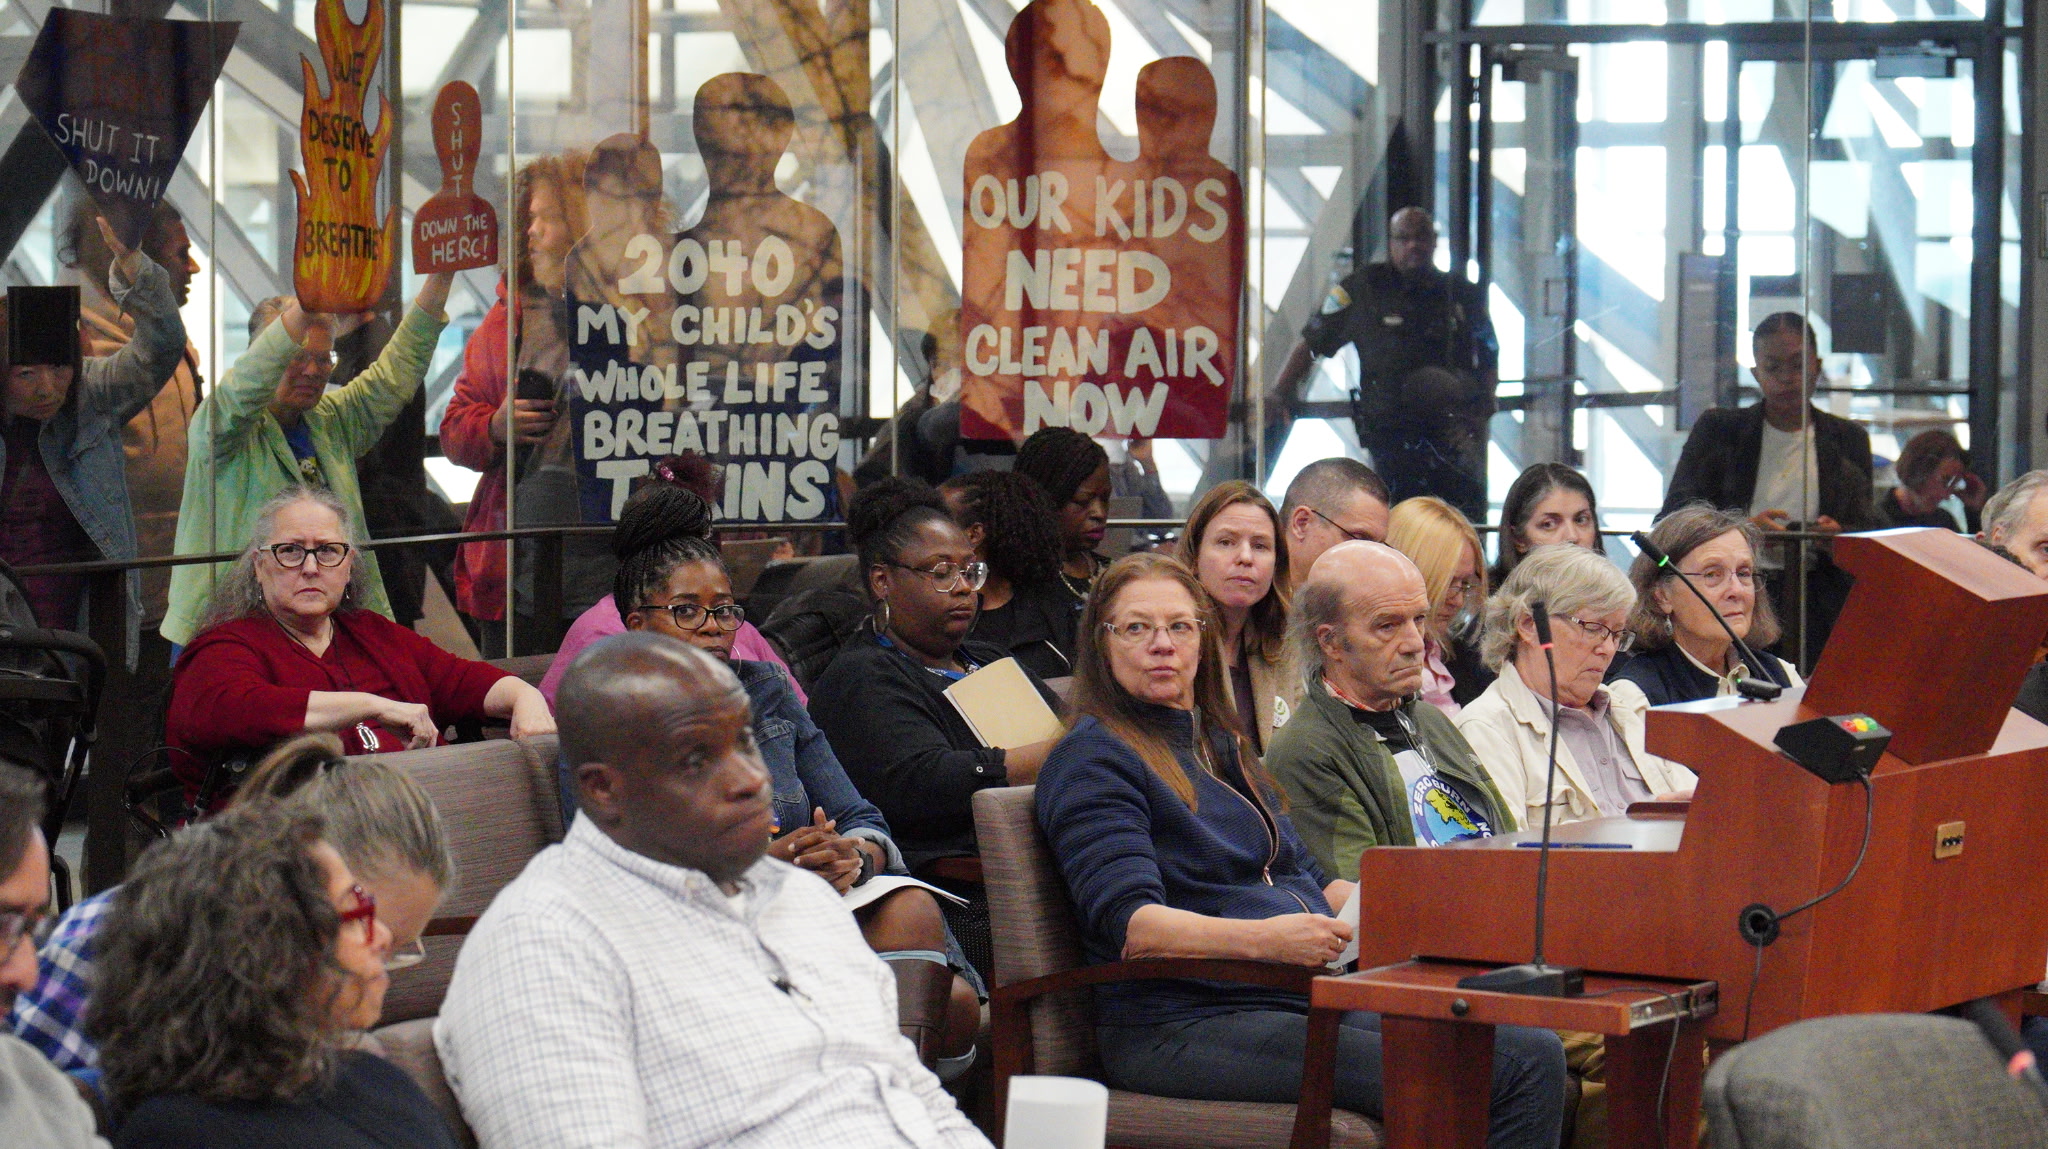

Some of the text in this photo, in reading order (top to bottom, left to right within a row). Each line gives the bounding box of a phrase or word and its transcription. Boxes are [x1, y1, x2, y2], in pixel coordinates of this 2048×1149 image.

[333, 51, 365, 87] WE
[55, 113, 160, 166] SHUT IT
[308, 109, 375, 158] DESERVE
[441, 102, 464, 197] SHUT
[85, 158, 160, 208] DOWN!
[323, 157, 351, 192] TO
[420, 212, 488, 241] DOWN THE
[969, 170, 1230, 243] OUR KIDS
[303, 220, 378, 260] BREATHE
[431, 234, 489, 266] HERC!
[618, 234, 795, 297] 2040
[1004, 247, 1172, 314] NEED
[577, 298, 839, 349] MY CHILD'S
[965, 323, 1225, 387] CLEAN AIR
[575, 358, 829, 405] WHOLE LIFE
[583, 408, 840, 461] BREATHING
[1022, 380, 1170, 438] NOW
[595, 458, 830, 522] TINS
